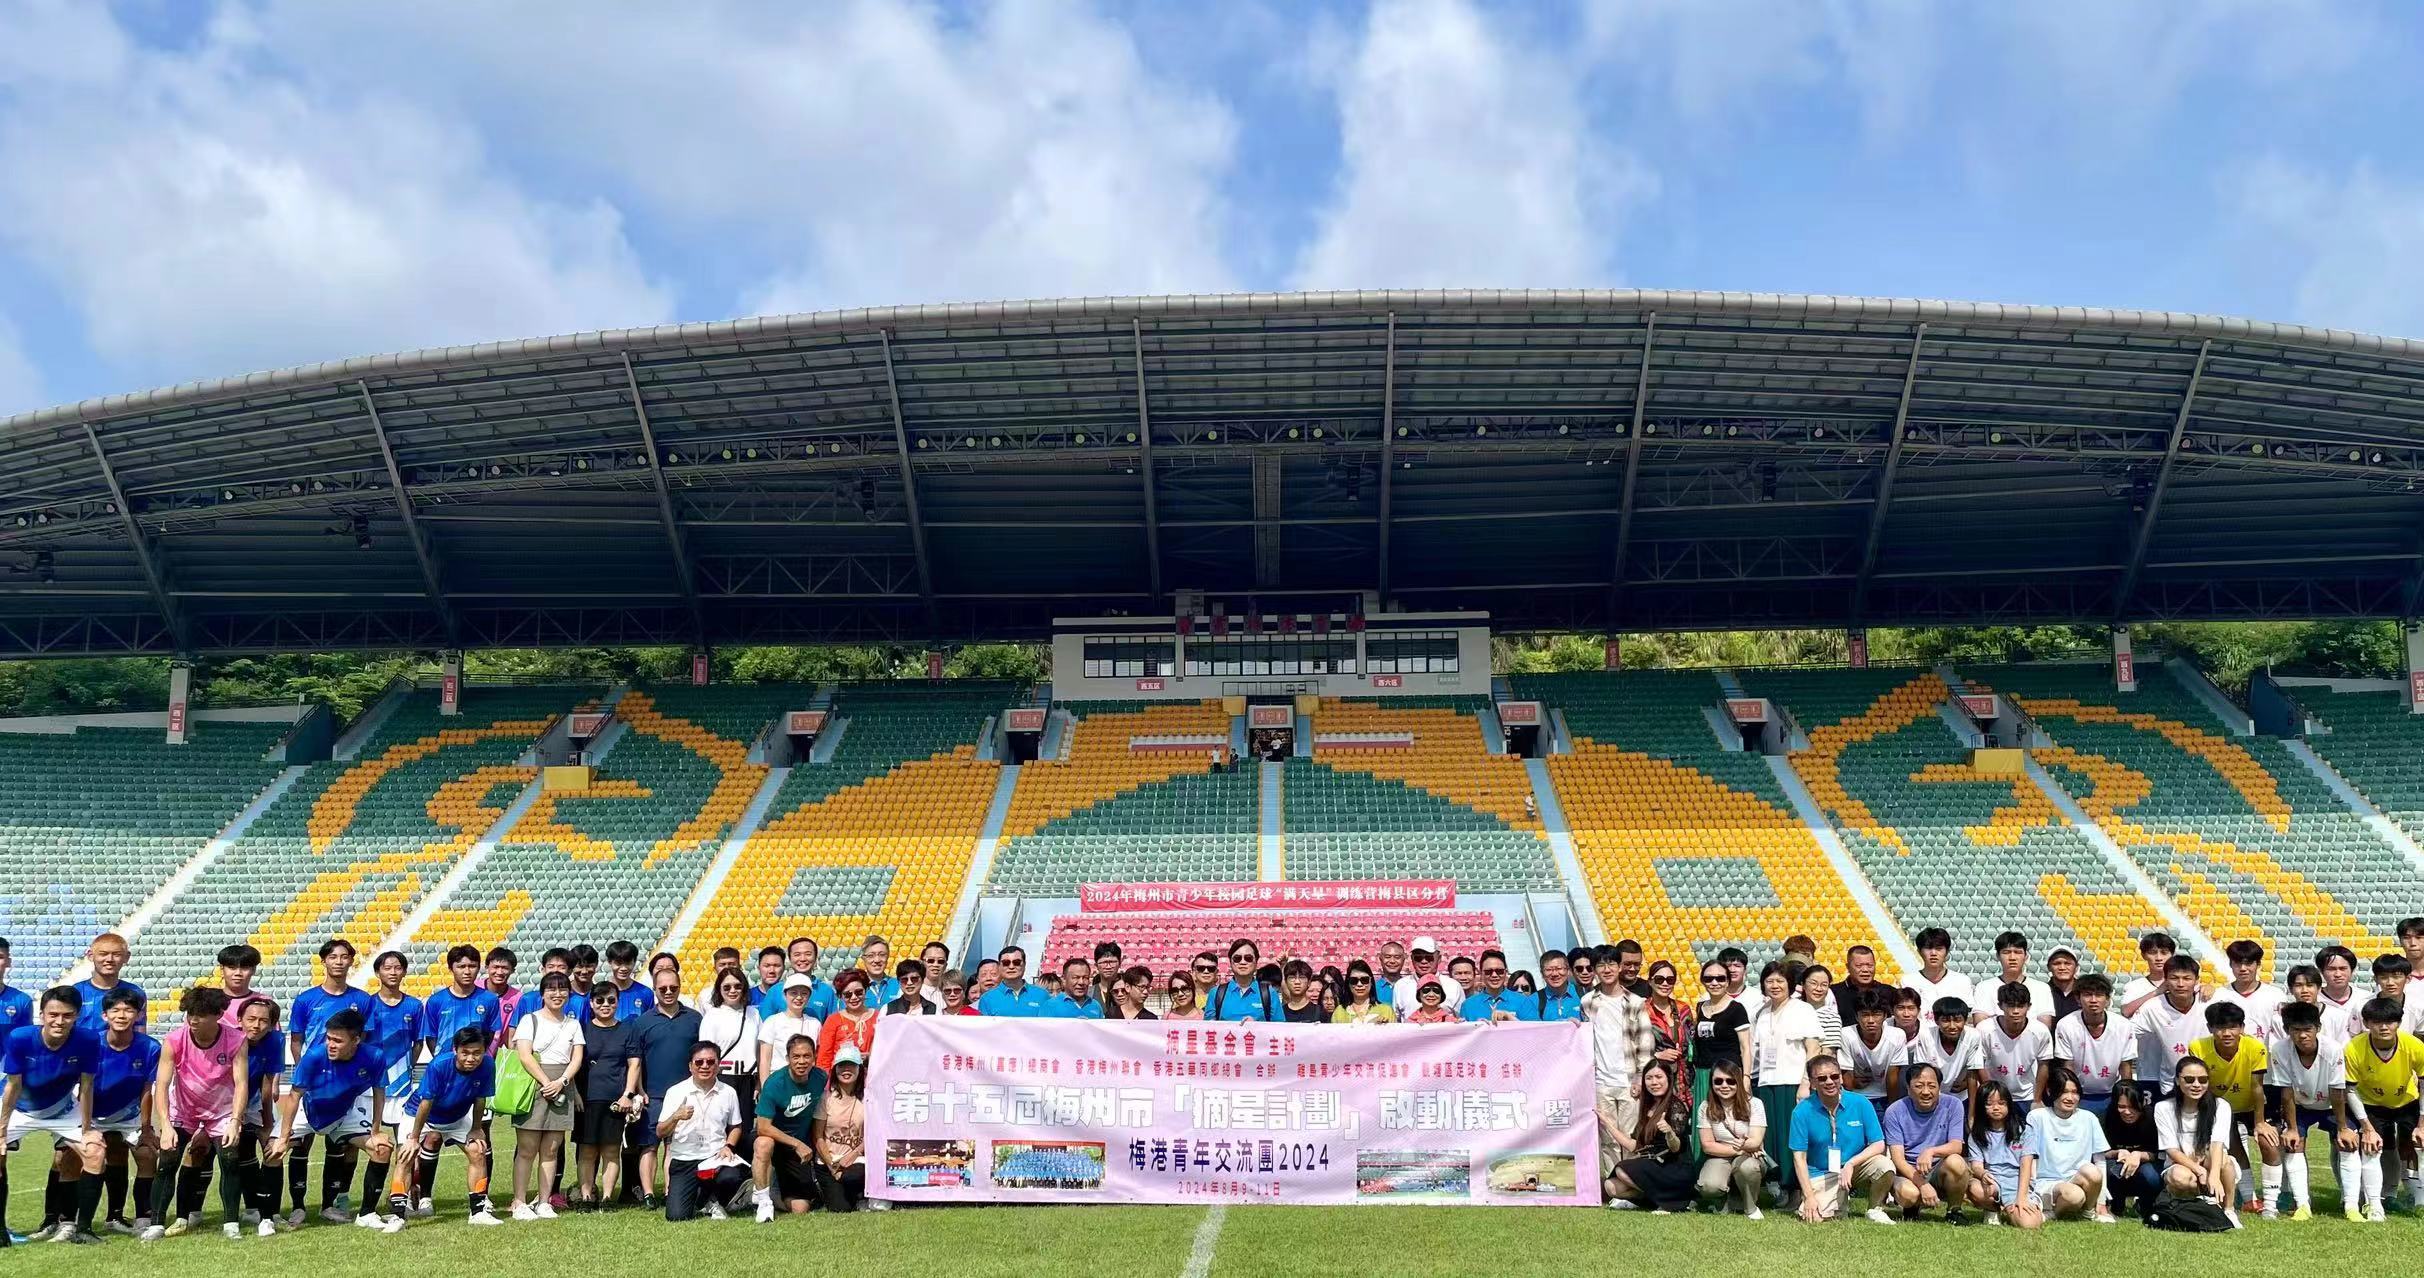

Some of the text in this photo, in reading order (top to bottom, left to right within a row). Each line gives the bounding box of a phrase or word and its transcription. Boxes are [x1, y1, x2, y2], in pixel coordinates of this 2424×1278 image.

[2120, 660, 2129, 681] 西九区
[445, 682, 454, 702] 西二区
[1140, 682, 1161, 690] 西五区
[1378, 679, 1398, 687] 西六区
[171, 709, 181, 731] 西一区
[1166, 1029, 1295, 1056] 摘星基金會 主辦
[788, 1092, 812, 1110] NIKE
[1544, 1098, 1573, 1130] 暨
[1129, 1137, 1330, 1174] 梅港青年交流團2024
[1178, 1181, 1281, 1196] 2024年8月9-11日
